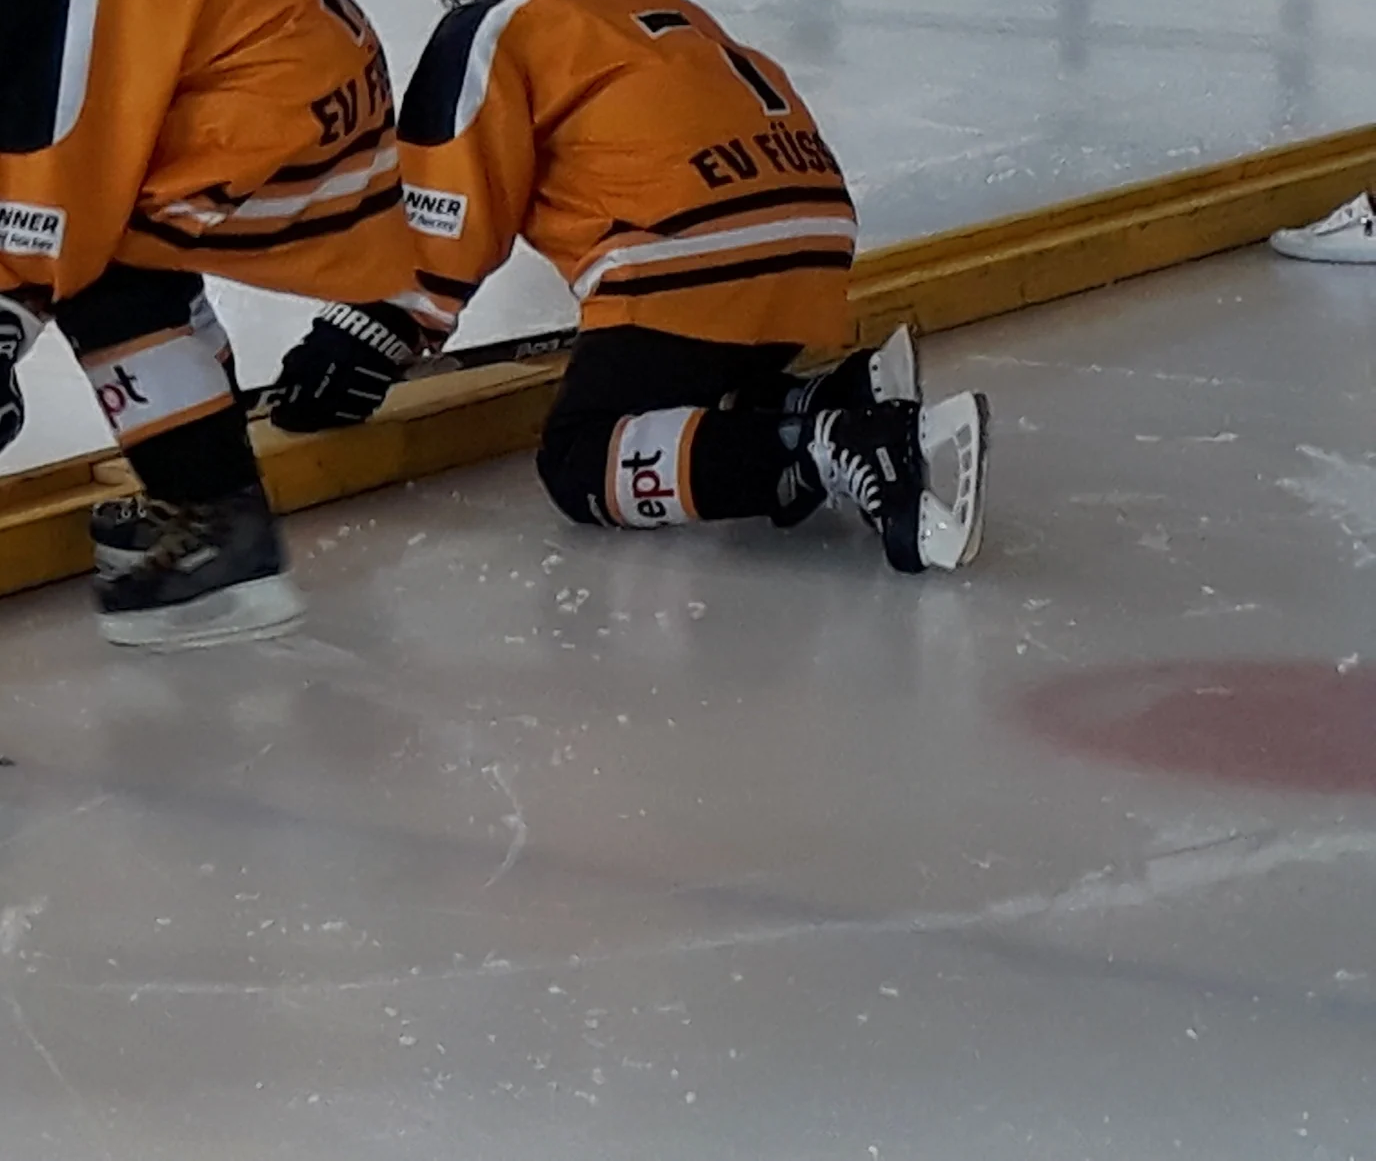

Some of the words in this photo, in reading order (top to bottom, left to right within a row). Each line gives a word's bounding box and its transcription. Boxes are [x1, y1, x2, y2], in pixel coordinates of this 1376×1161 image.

[310, 78, 358, 147] EV
[688, 138, 758, 189] EV
[621, 449, 674, 518] ept
